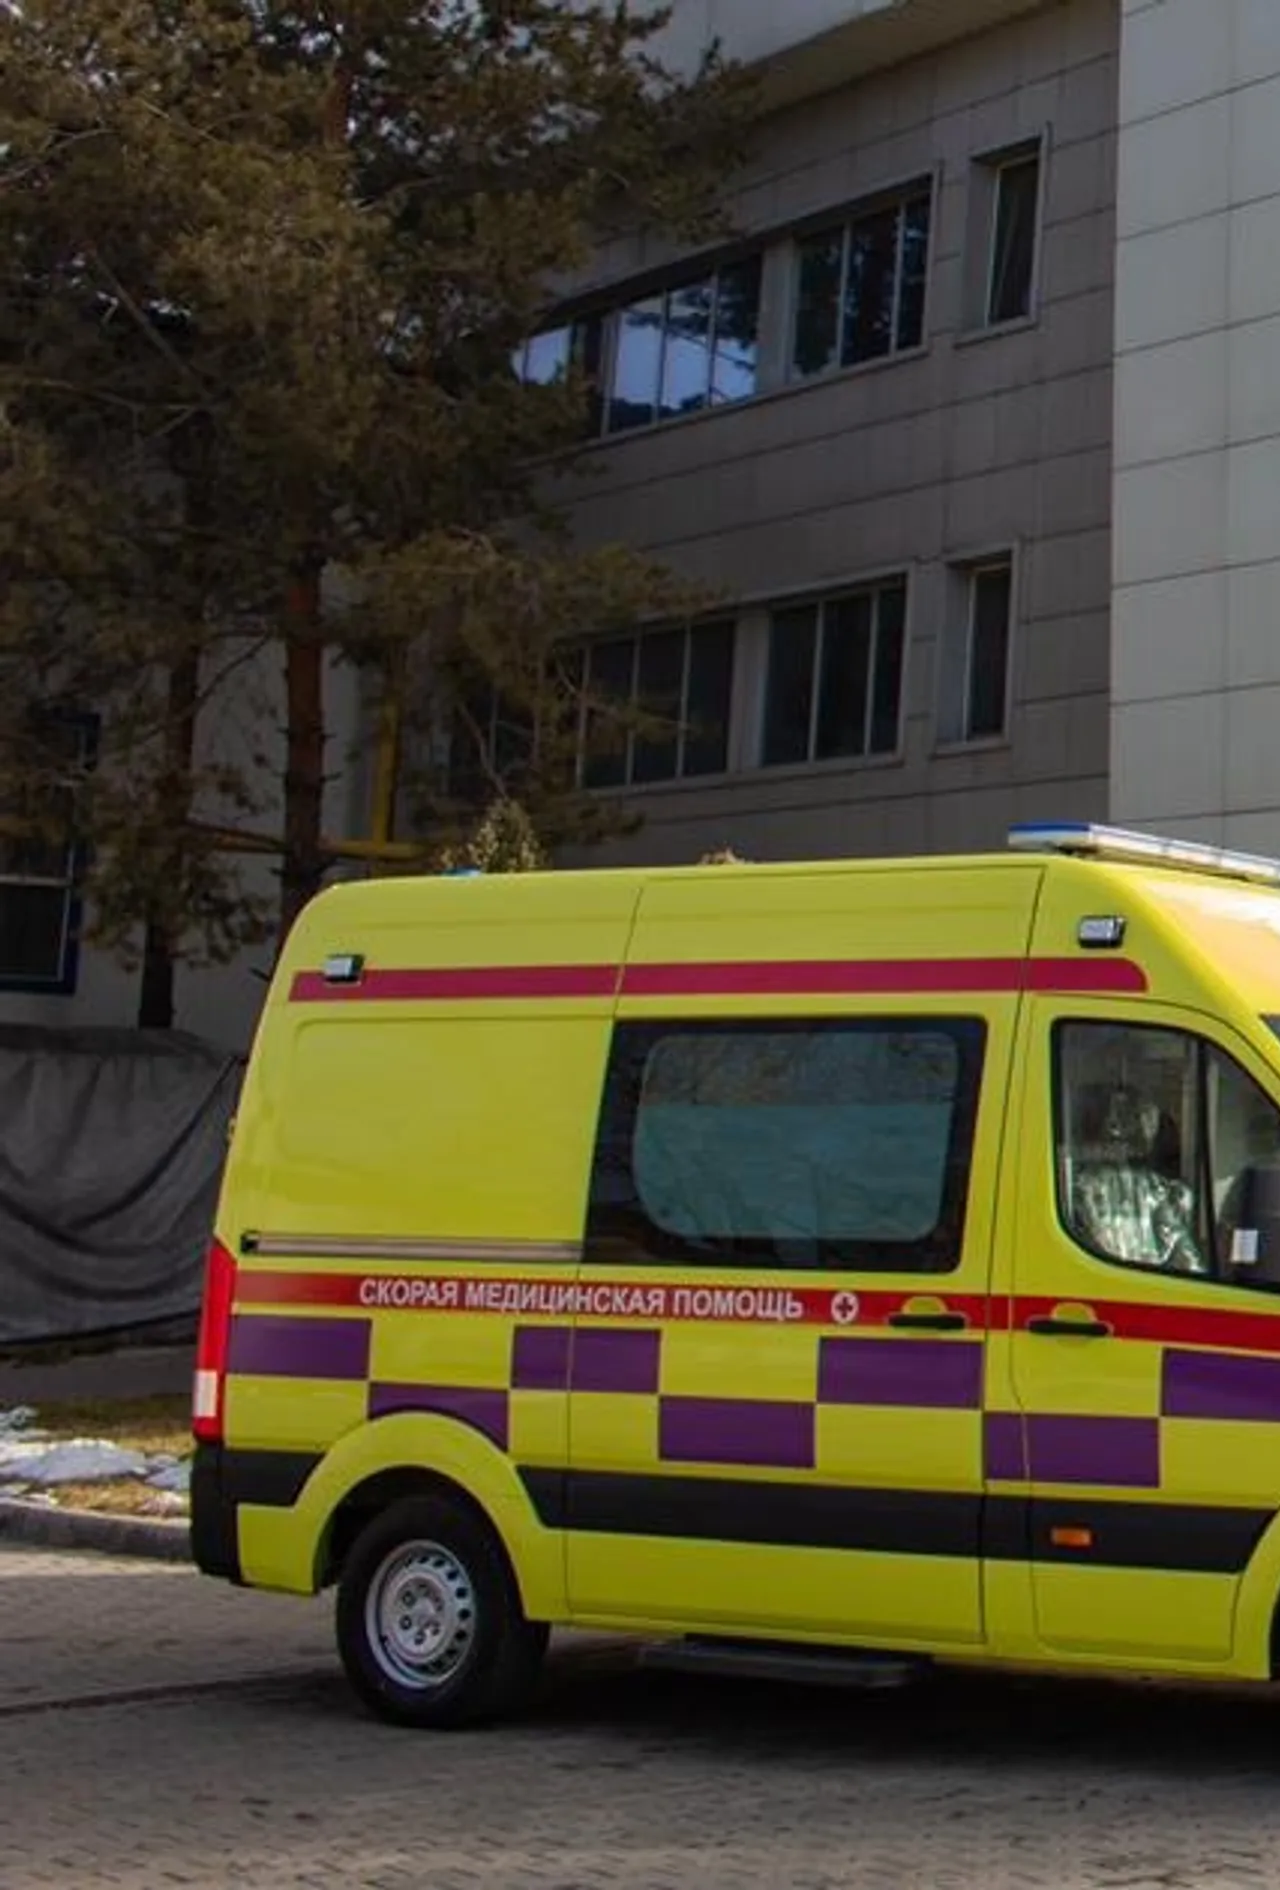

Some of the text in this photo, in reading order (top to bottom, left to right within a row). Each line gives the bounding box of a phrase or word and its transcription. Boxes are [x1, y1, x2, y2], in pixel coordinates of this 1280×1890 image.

[359, 1278, 804, 1321] СКОРАЯ МЕДИЦИНСКАЯ ПОМОЩЬ
